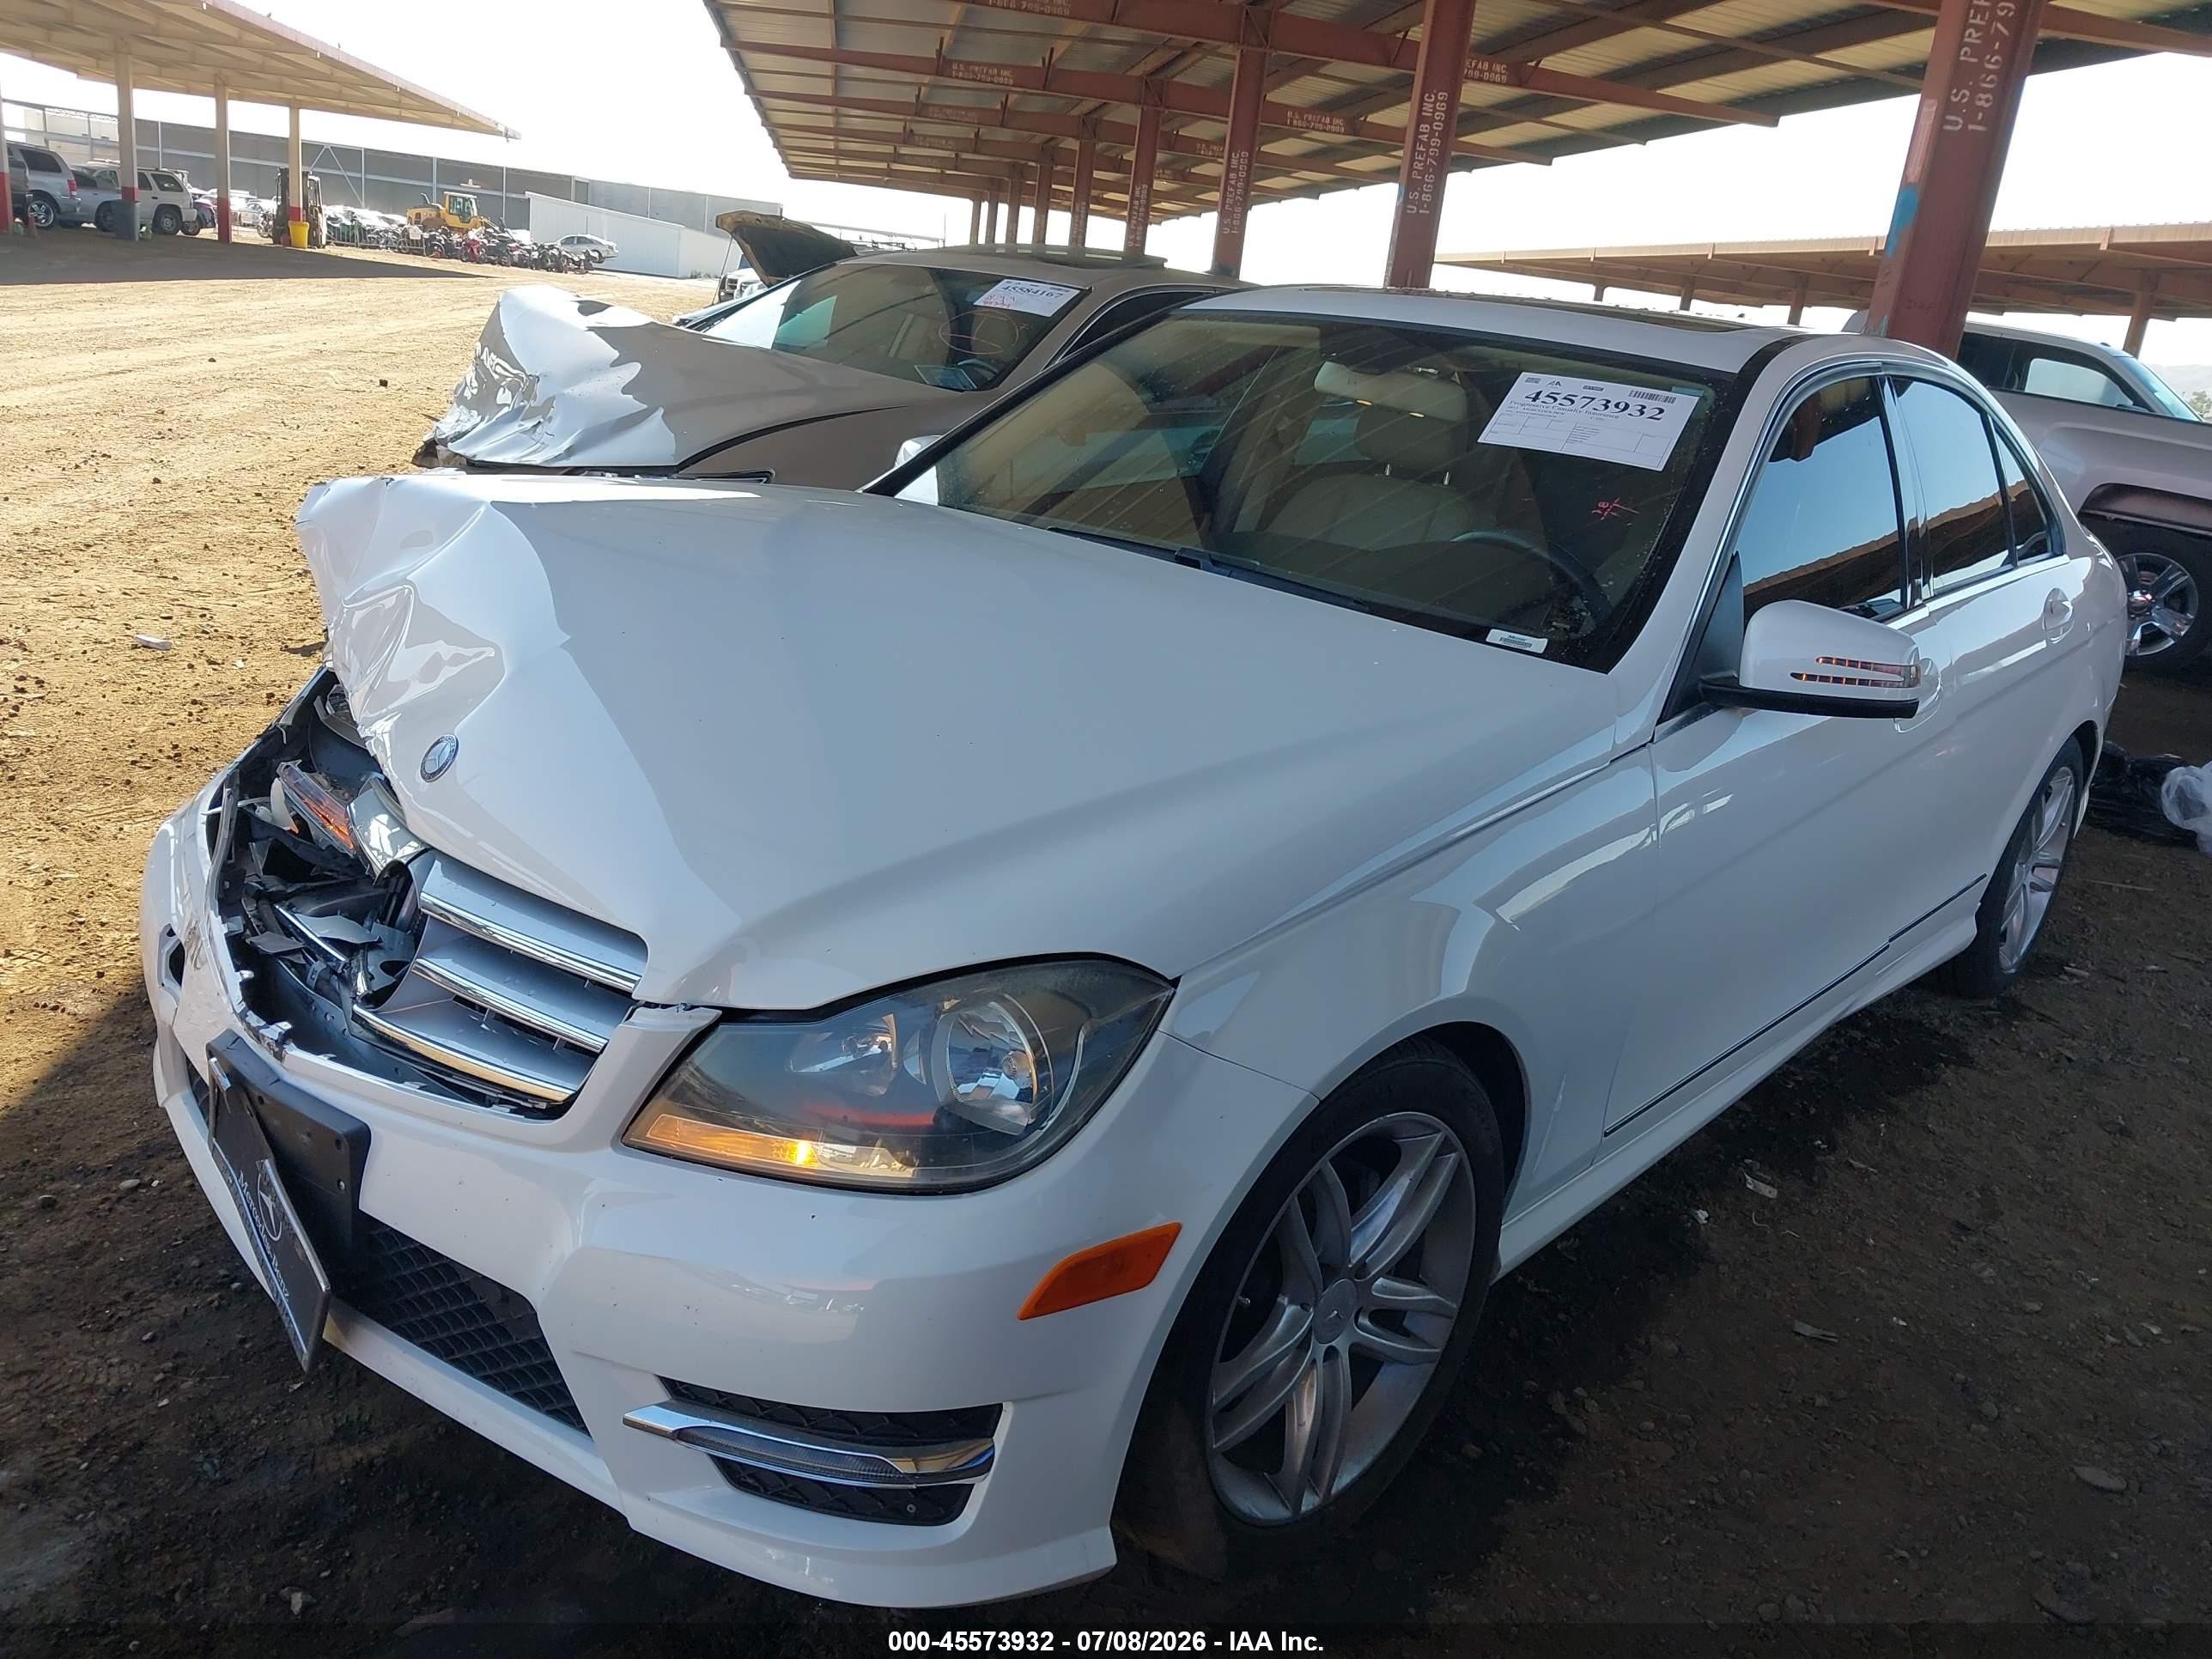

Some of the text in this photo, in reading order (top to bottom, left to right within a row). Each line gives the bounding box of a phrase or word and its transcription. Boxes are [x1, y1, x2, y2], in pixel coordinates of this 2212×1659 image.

[1942, 0, 1991, 131] U.S. PRE
[1407, 89, 1437, 214] U.S. PREFAB INC.
[1419, 91, 1449, 214] 1-866-799-0969
[1524, 390, 1665, 421] 45573932
[238, 1170, 289, 1301] Mercedes-Benz
